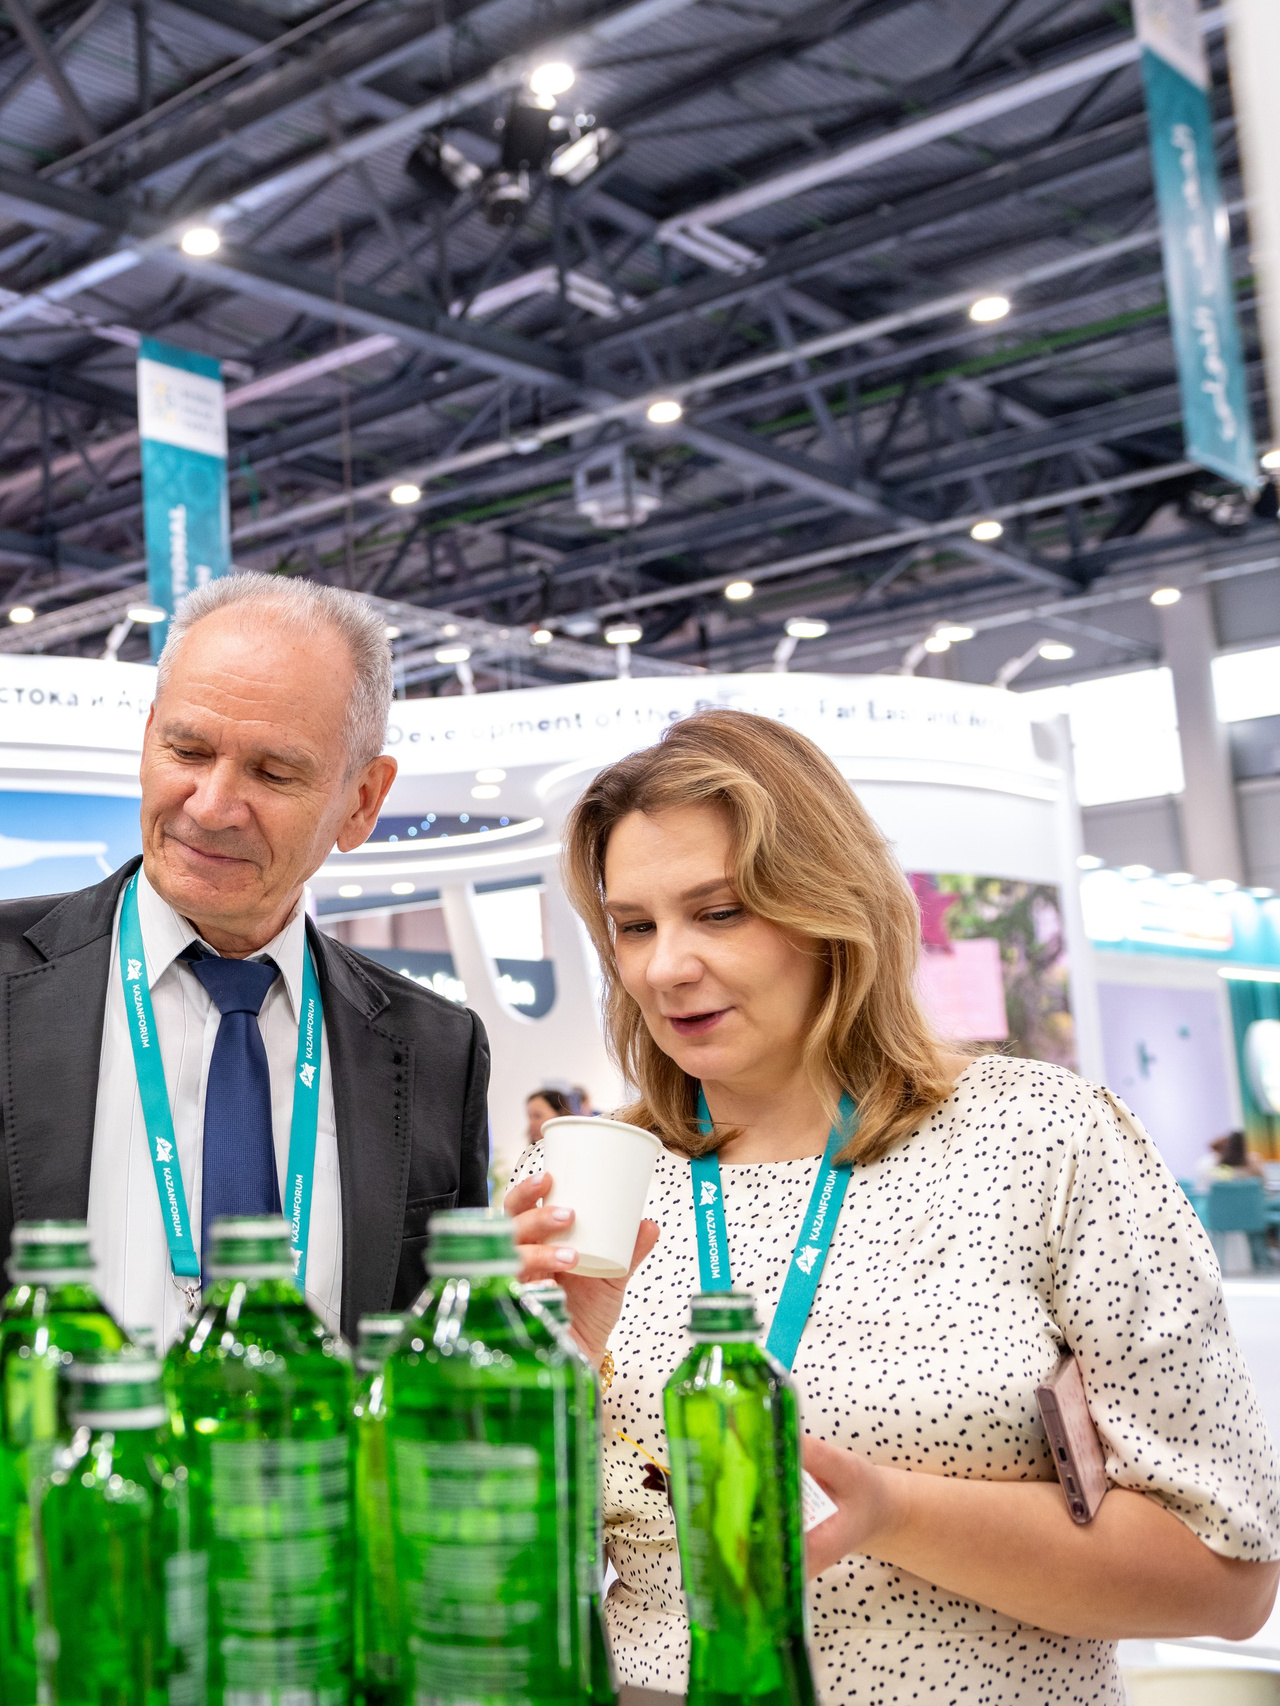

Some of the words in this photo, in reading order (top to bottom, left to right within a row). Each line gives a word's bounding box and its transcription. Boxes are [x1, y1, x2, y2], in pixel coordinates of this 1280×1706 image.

[132, 984, 150, 1048] KAZANFORUM
[305, 998, 315, 1060] KAZANFORUM
[163, 1167, 183, 1237] KAZANFORUM
[292, 1174, 304, 1243] KAZANFORUM
[809, 1170, 838, 1241] KAZANFORUM
[705, 1209, 721, 1279] KAZANFORUM
